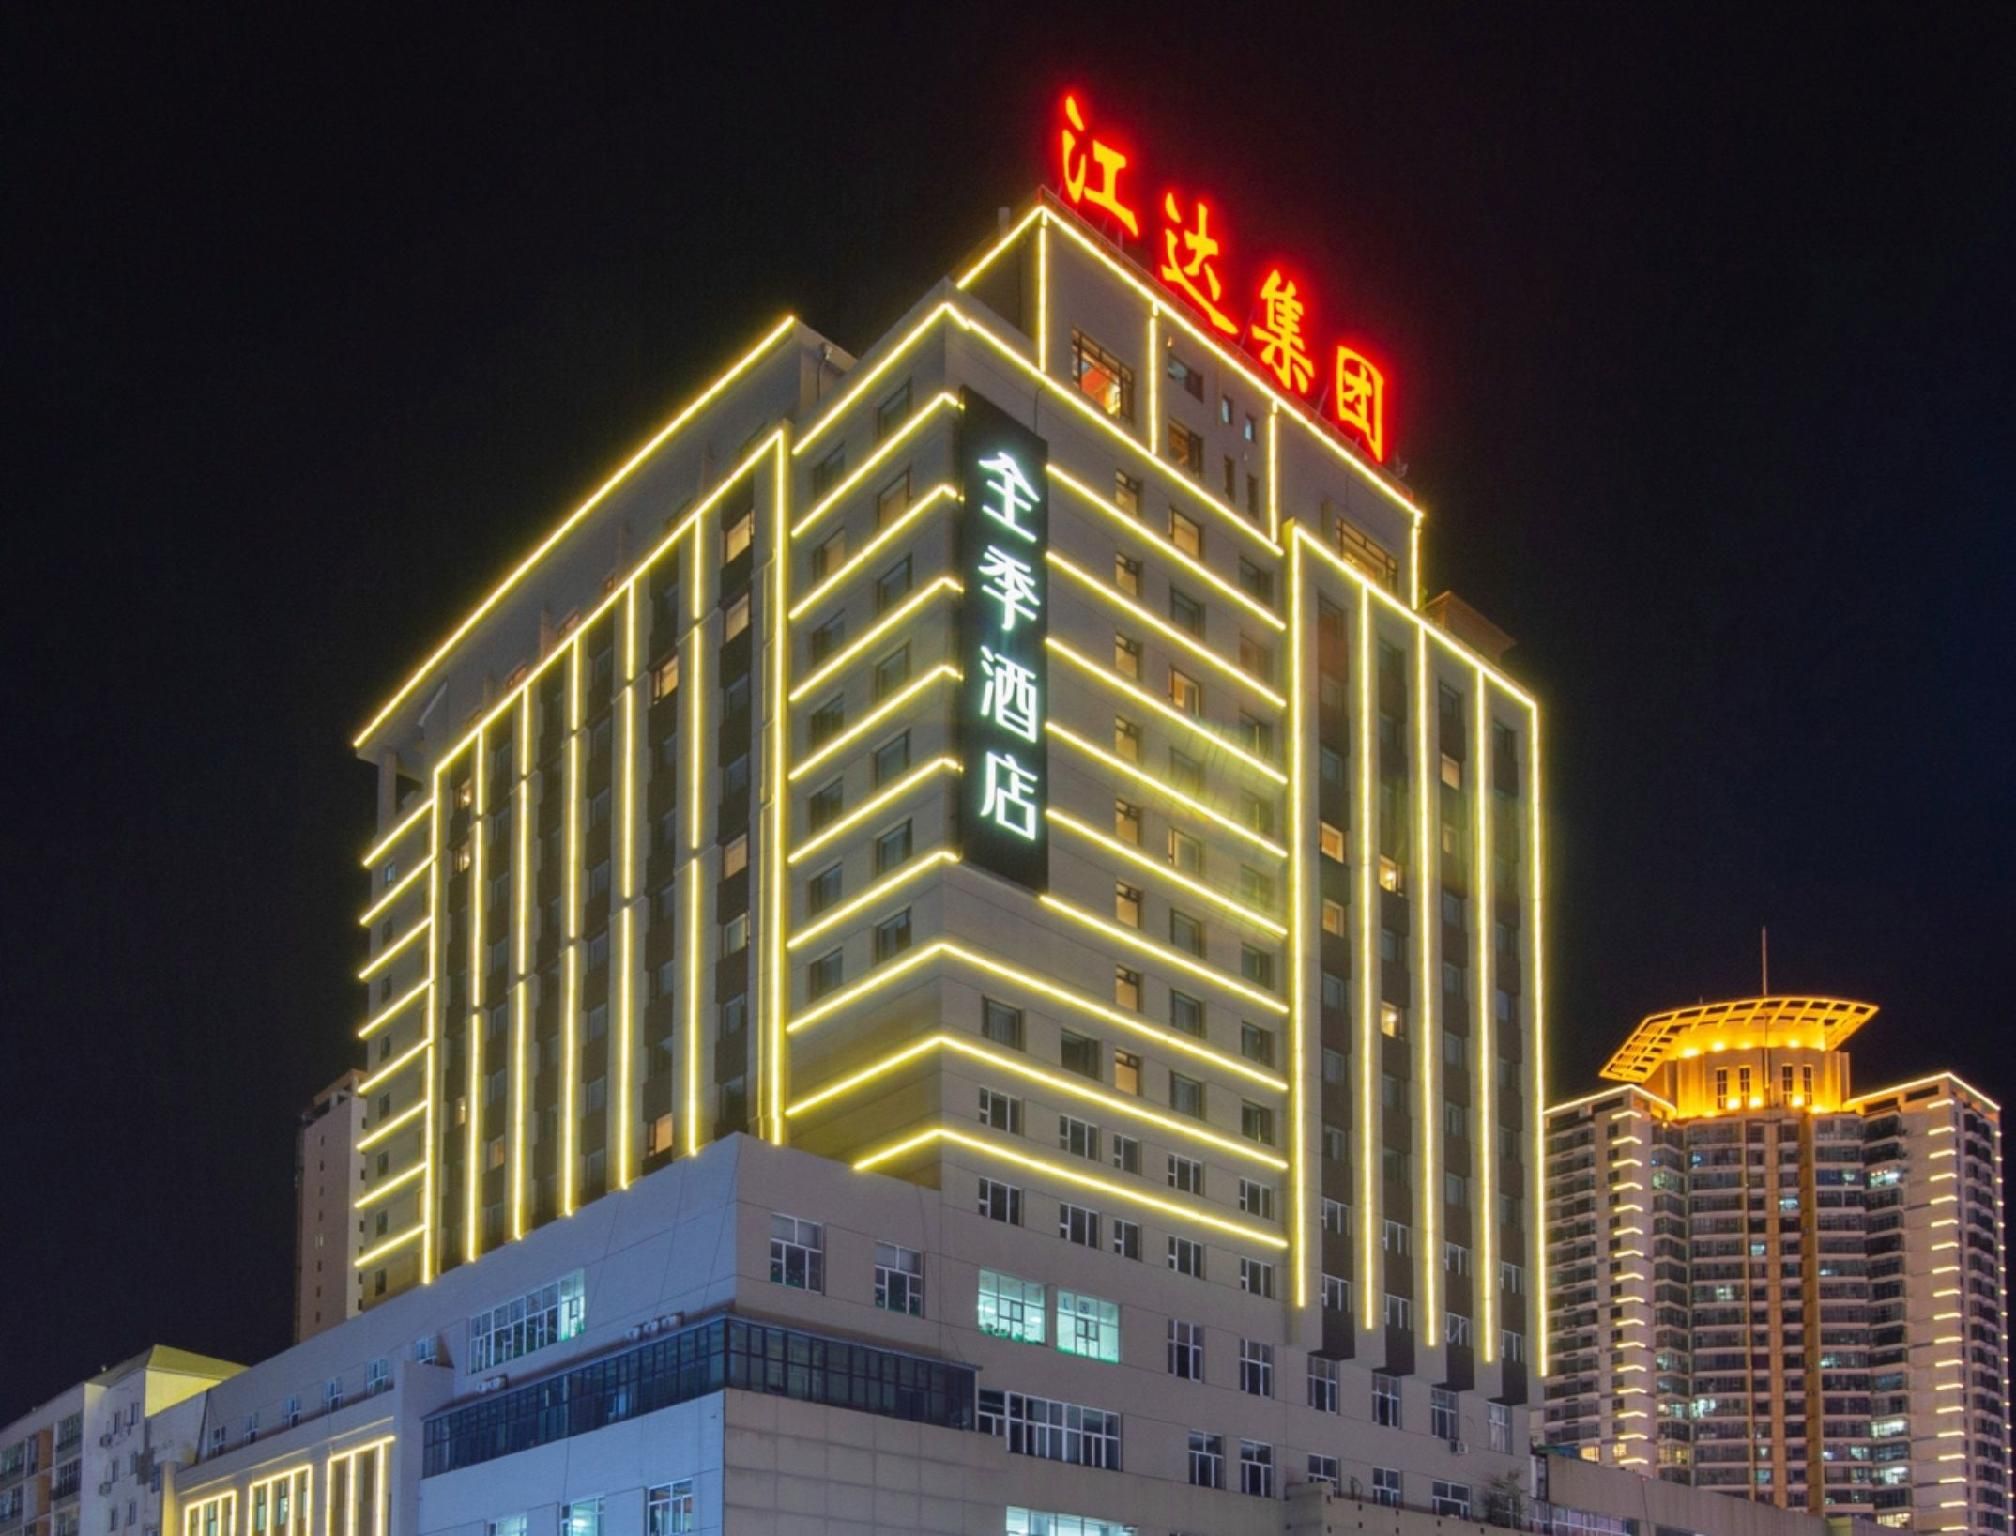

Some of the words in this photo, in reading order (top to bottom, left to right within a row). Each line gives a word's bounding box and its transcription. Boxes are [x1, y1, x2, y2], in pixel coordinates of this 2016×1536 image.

[1061, 95, 1384, 462] 江达集团
[978, 451, 1040, 841] 全季酒店
